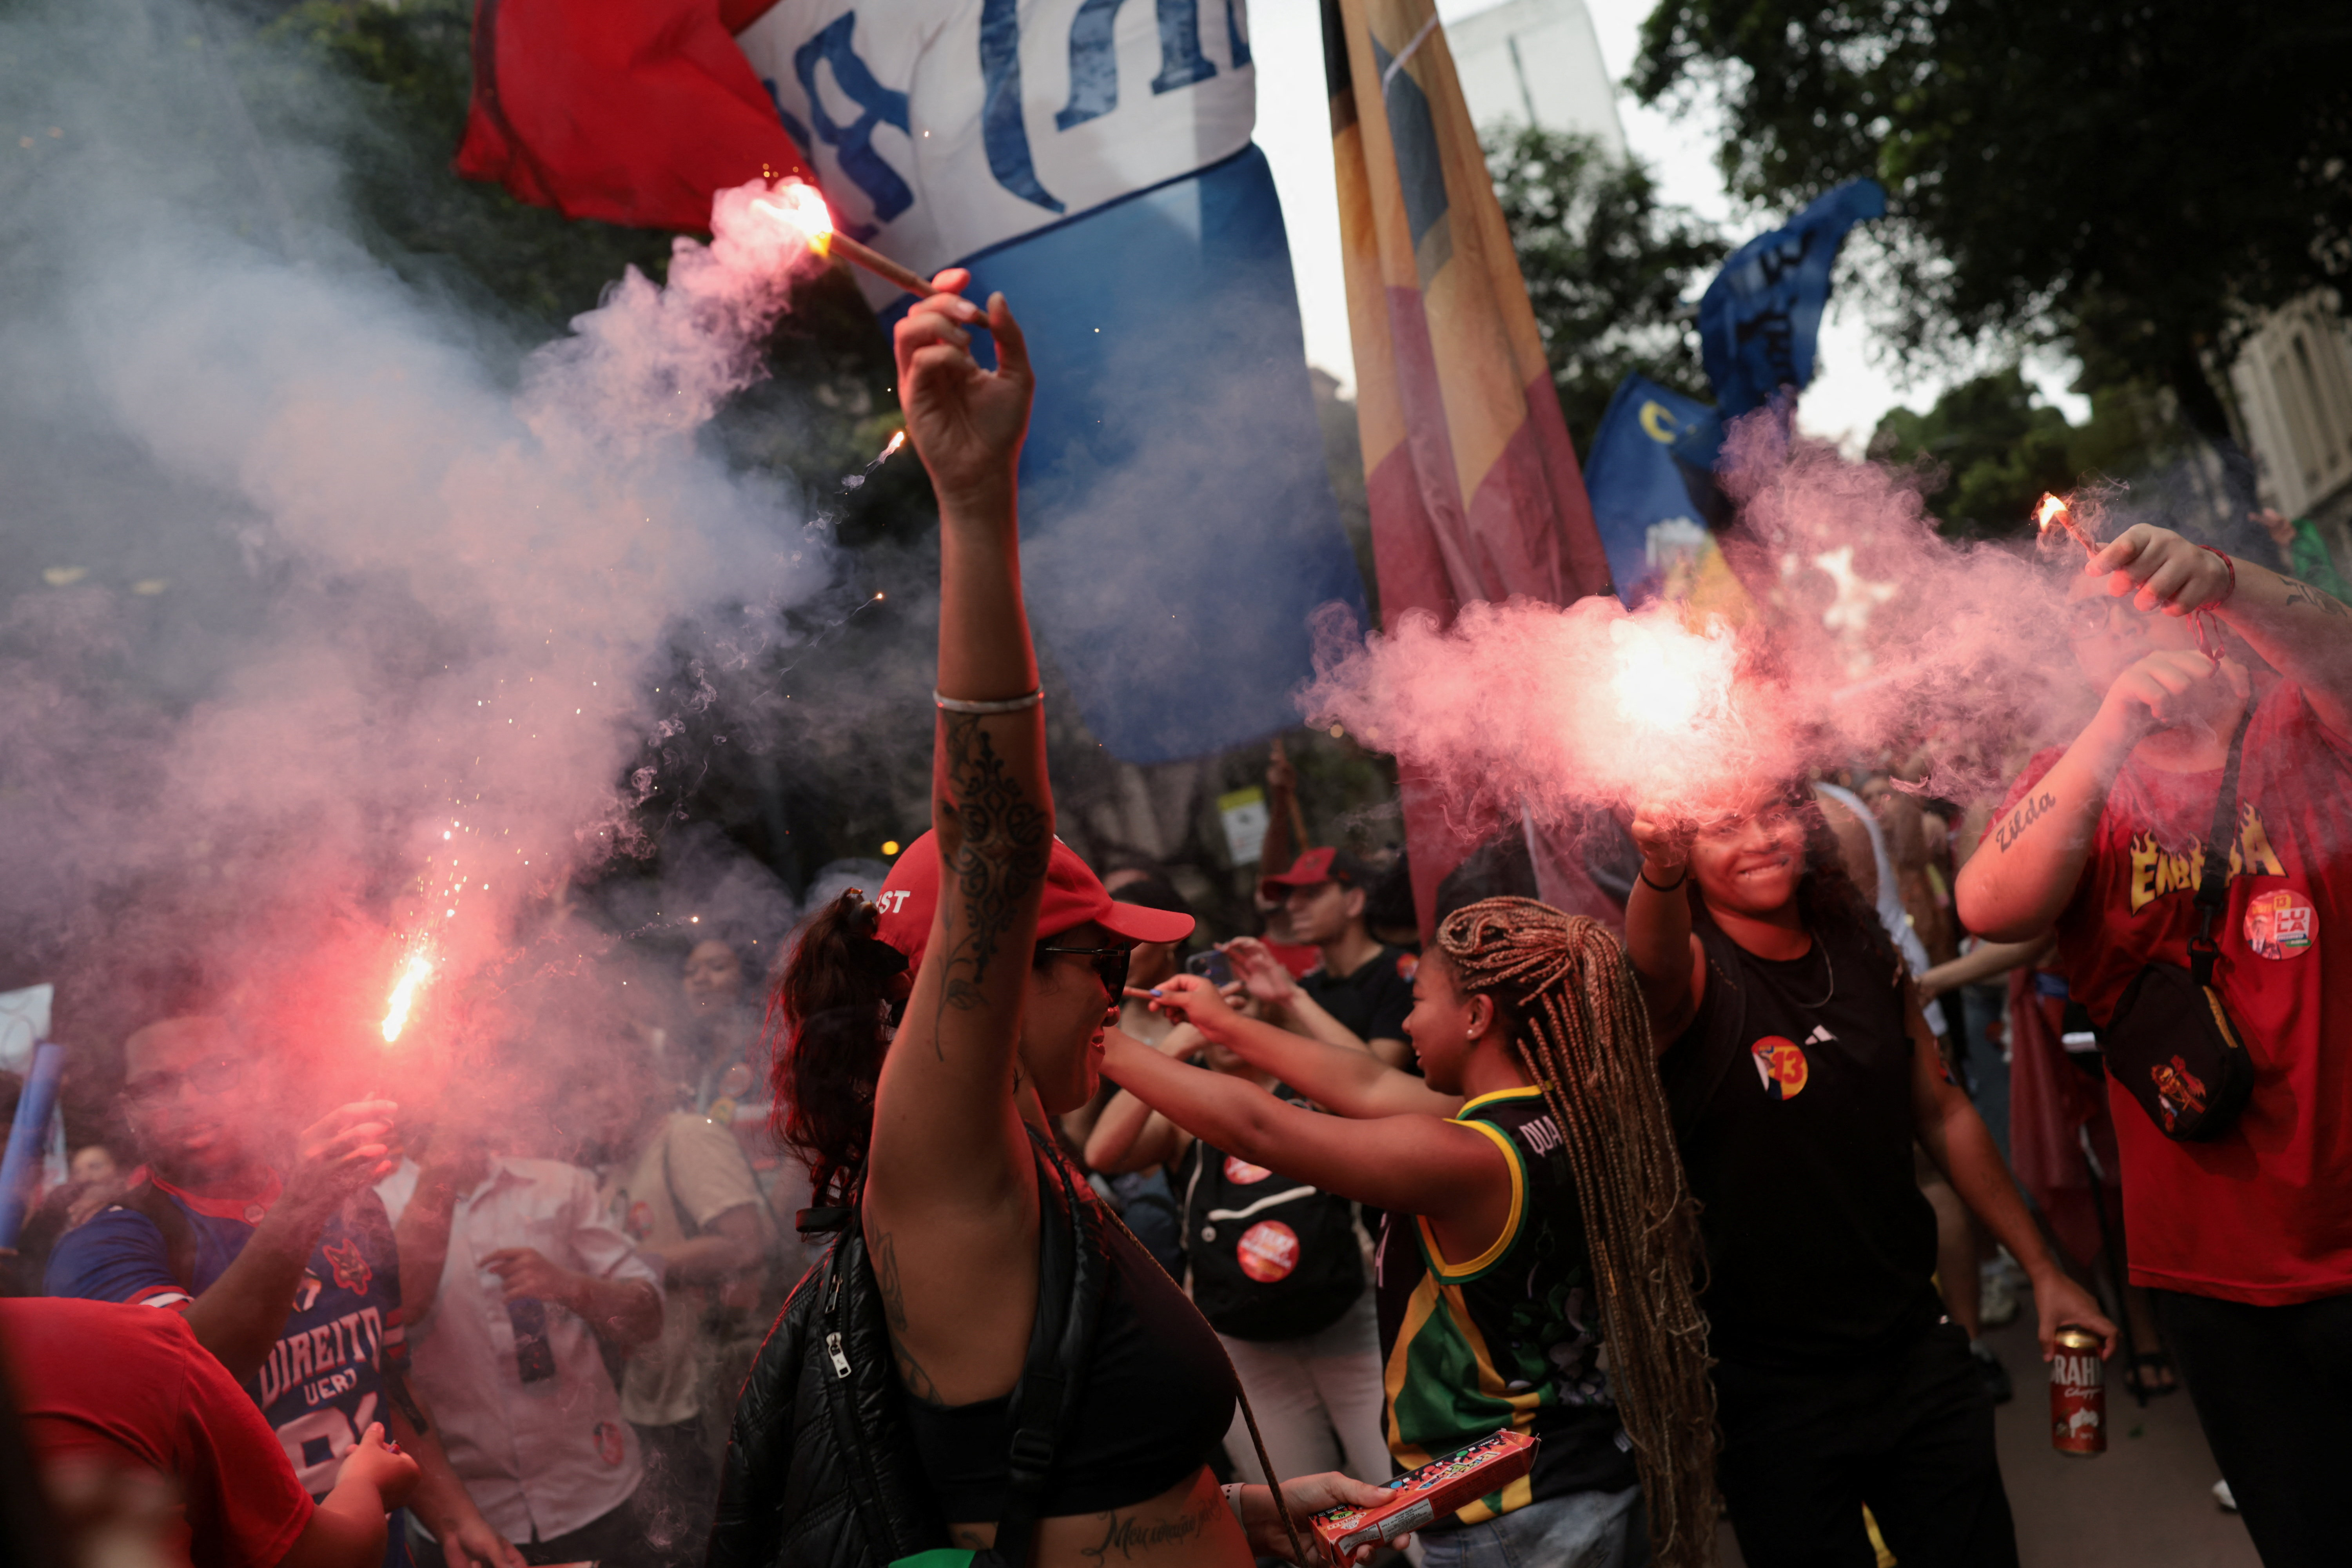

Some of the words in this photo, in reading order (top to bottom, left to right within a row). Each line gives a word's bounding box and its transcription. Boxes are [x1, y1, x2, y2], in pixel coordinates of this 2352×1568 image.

[1996, 792, 2056, 853] Zilda
[876, 890, 911, 914] ST
[2276, 897, 2288, 907] 13
[2278, 910, 2305, 922] LU
[2277, 922, 2305, 933] LA
[1772, 1050, 1804, 1084] 13
[2051, 1354, 2102, 1386] RAH
[304, 1367, 357, 1406] UERJ
